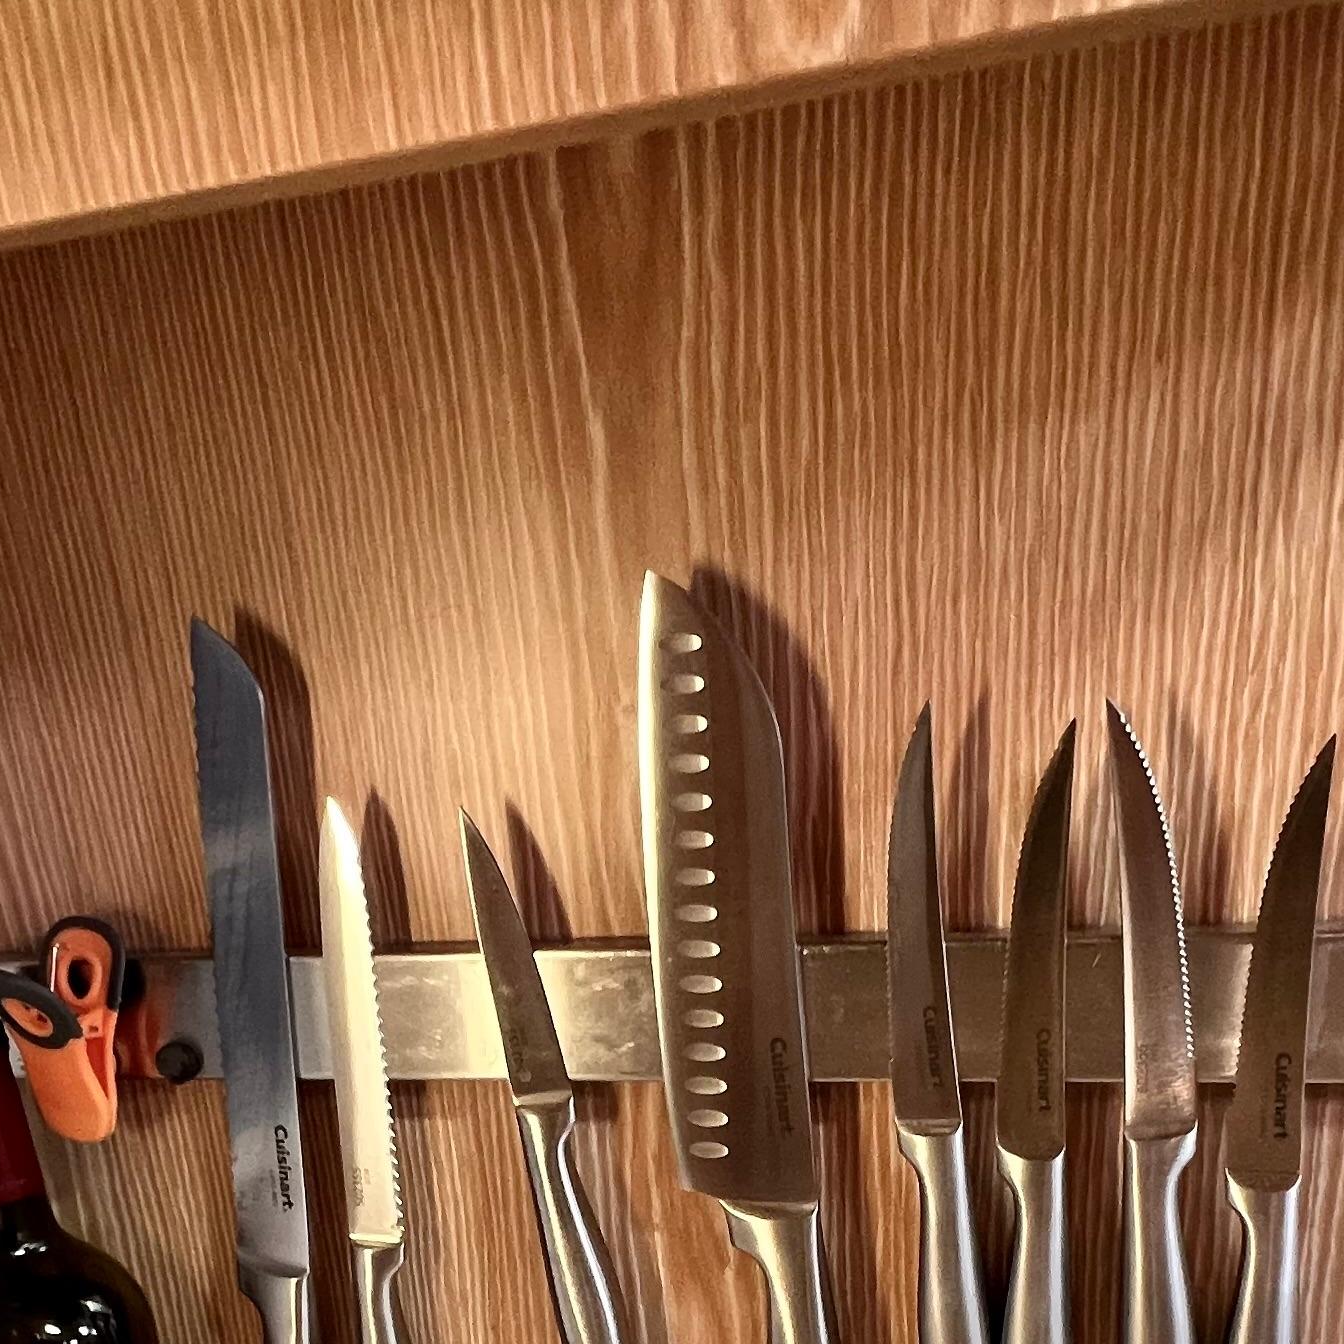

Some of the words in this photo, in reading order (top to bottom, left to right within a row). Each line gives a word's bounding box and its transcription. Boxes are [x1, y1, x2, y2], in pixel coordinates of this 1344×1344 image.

[769, 1037, 795, 1136] Cuisinart
[1273, 1052, 1293, 1141] Cuisinart
[273, 1124, 295, 1211] Cuisinart
